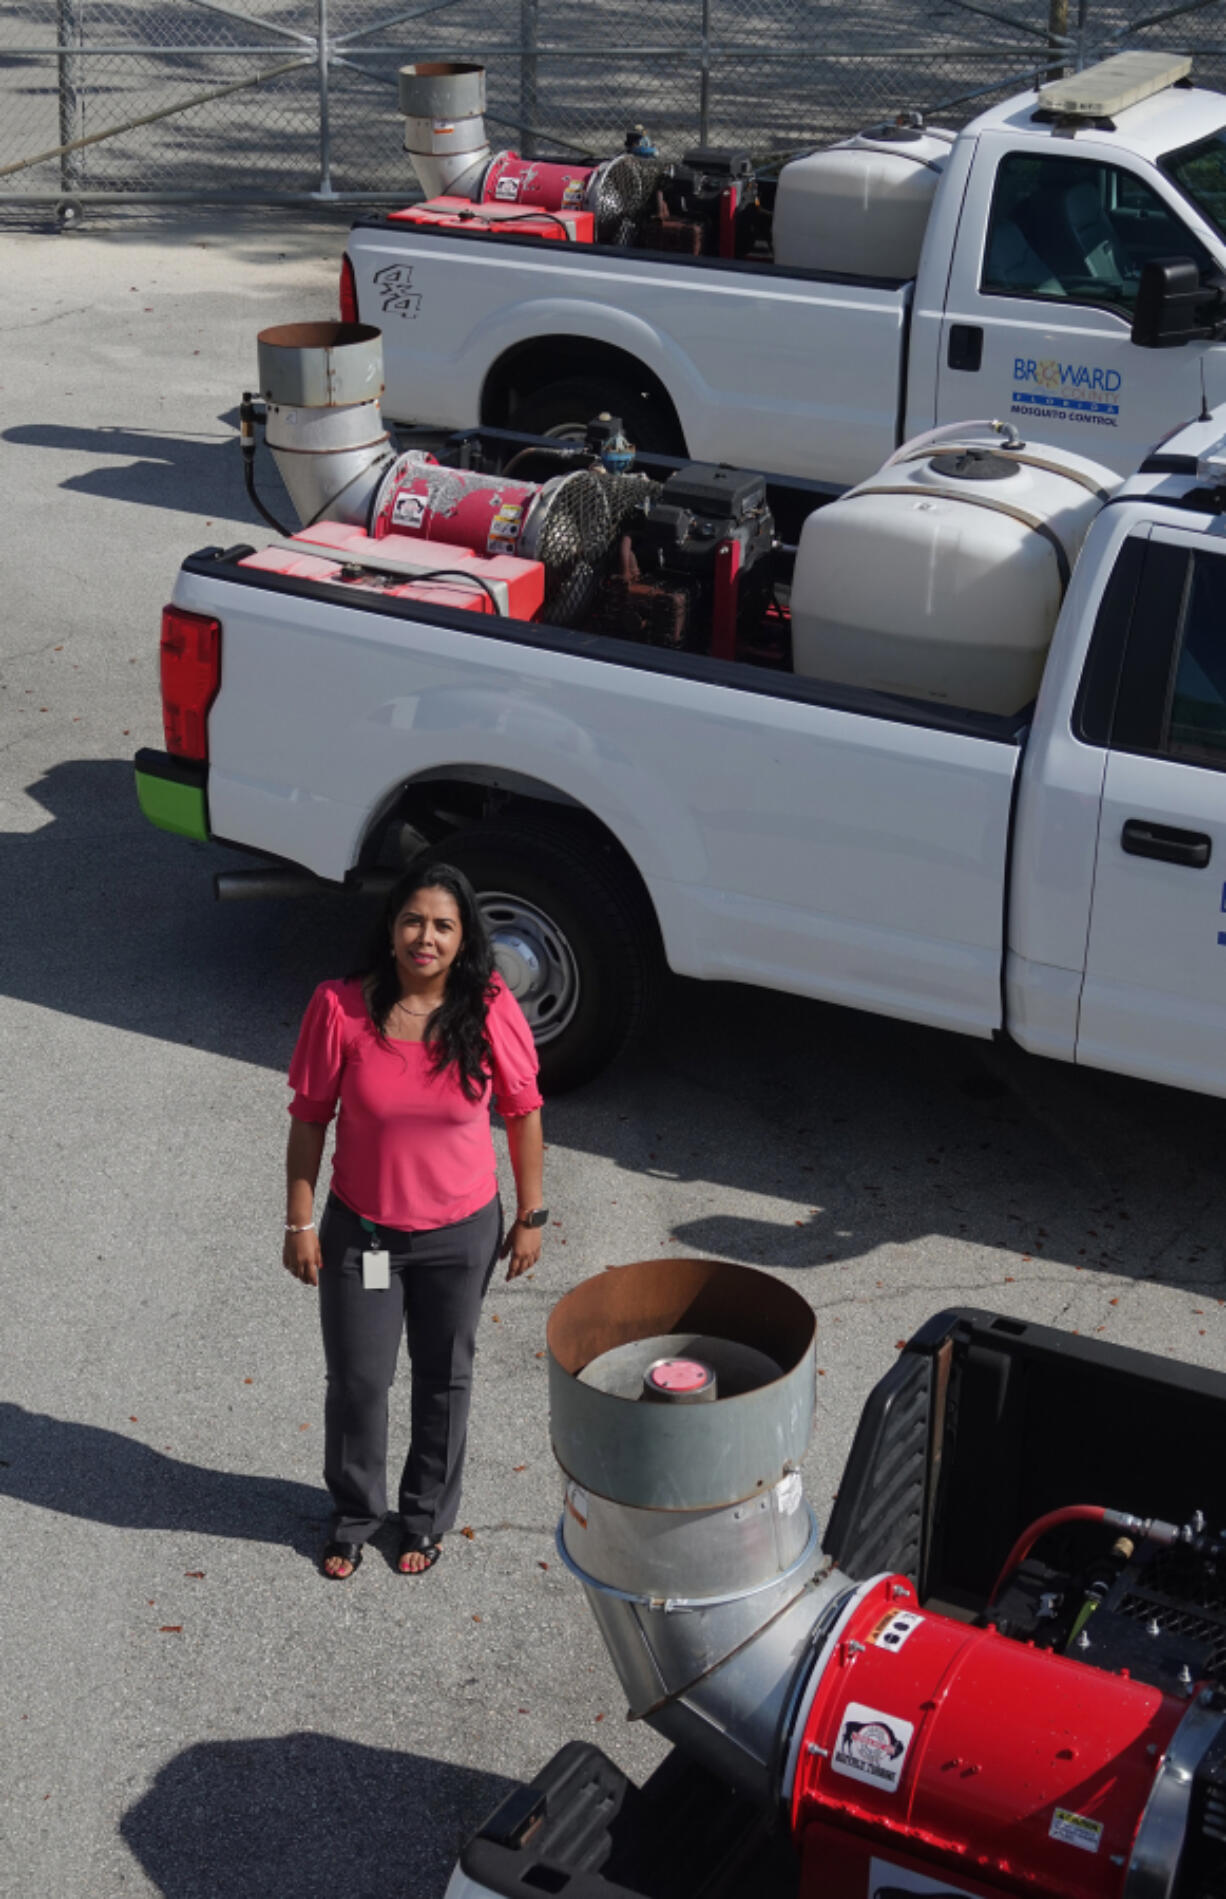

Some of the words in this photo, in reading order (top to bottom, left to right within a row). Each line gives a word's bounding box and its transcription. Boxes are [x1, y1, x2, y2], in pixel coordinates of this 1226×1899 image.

[1014, 358, 1121, 391] BROWARD
[1015, 394, 1114, 414] FLORIDA
[1061, 386, 1120, 403] COUNTY
[1011, 404, 1066, 420] MOSQUITO
[1068, 411, 1118, 427] CONTROL
